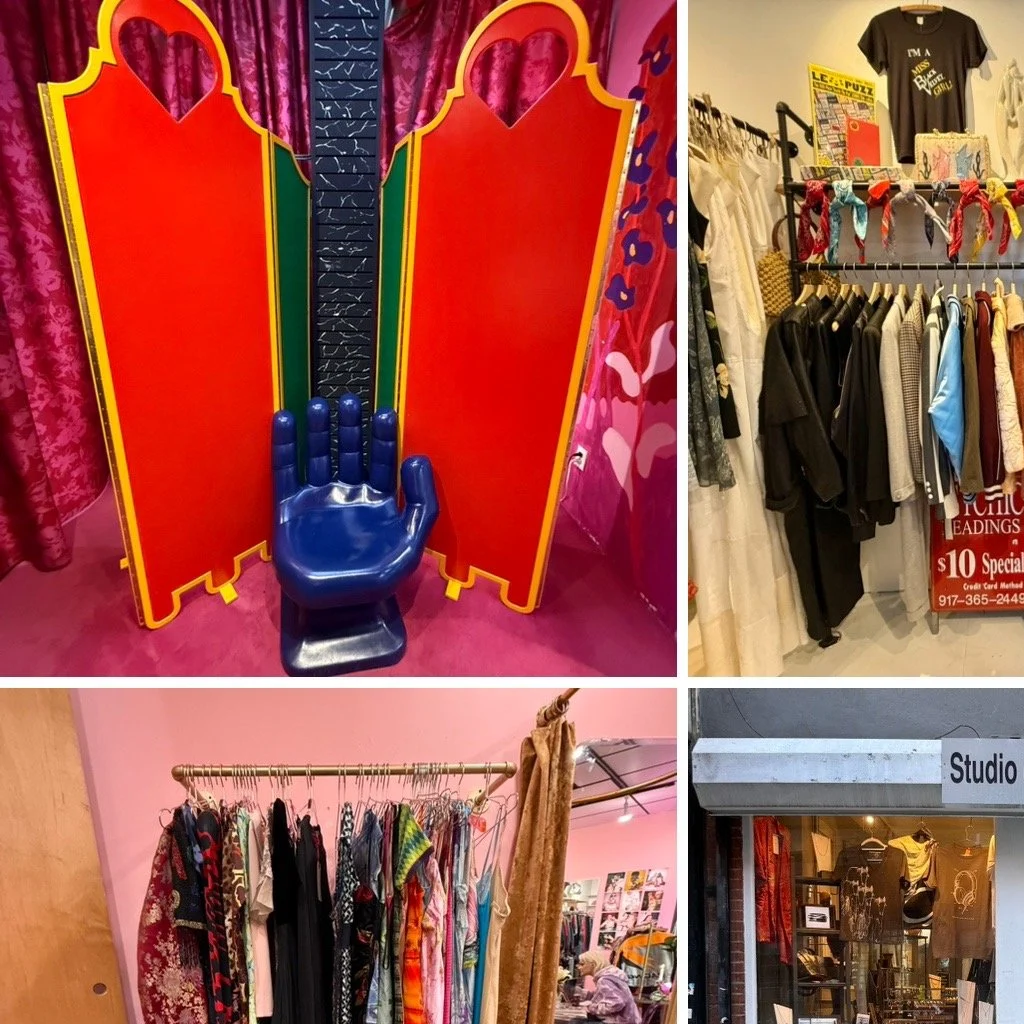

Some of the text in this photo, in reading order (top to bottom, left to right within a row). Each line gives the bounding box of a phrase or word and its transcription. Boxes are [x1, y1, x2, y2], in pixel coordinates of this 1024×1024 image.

[911, 59, 930, 77] MISS
[811, 71, 828, 84] LE
[844, 80, 874, 97] PUZZ
[952, 518, 1021, 536] EADINGS
[937, 548, 1024, 580] $10 Special
[963, 581, 1024, 591] Credit Card Method
[950, 752, 1017, 785] Studio
